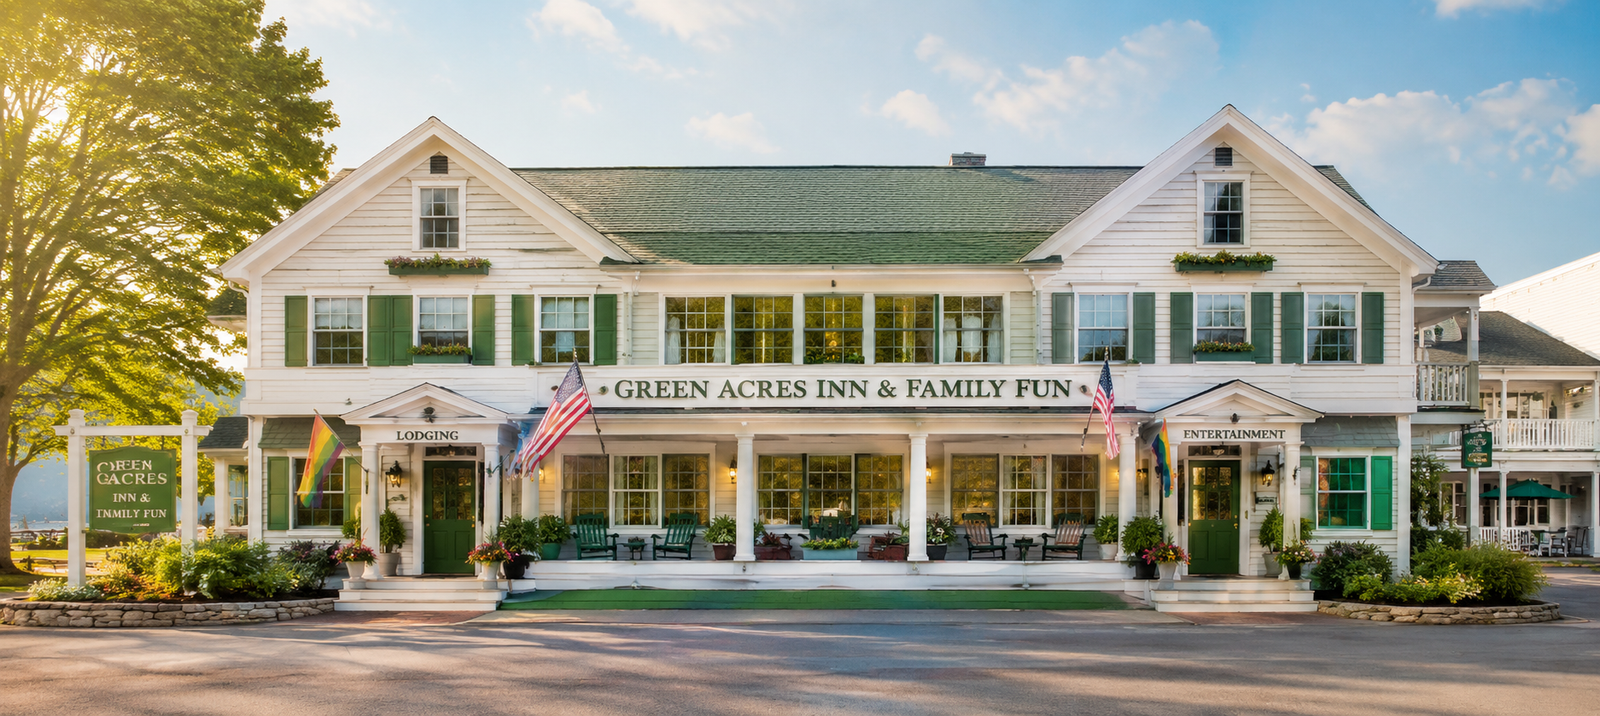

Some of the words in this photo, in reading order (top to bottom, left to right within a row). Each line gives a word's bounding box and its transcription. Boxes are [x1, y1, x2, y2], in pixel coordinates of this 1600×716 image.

[614, 379, 710, 399] GREEN
[717, 379, 807, 399] ACRES
[815, 379, 869, 399] INN
[877, 379, 897, 398] &
[905, 379, 1007, 398] FAMILY
[1015, 379, 1073, 398] FUN
[396, 430, 459, 441] LODGING
[1183, 429, 1286, 440] ENTERTAINMENT
[112, 493, 137, 503] INN
[139, 493, 151, 503] &
